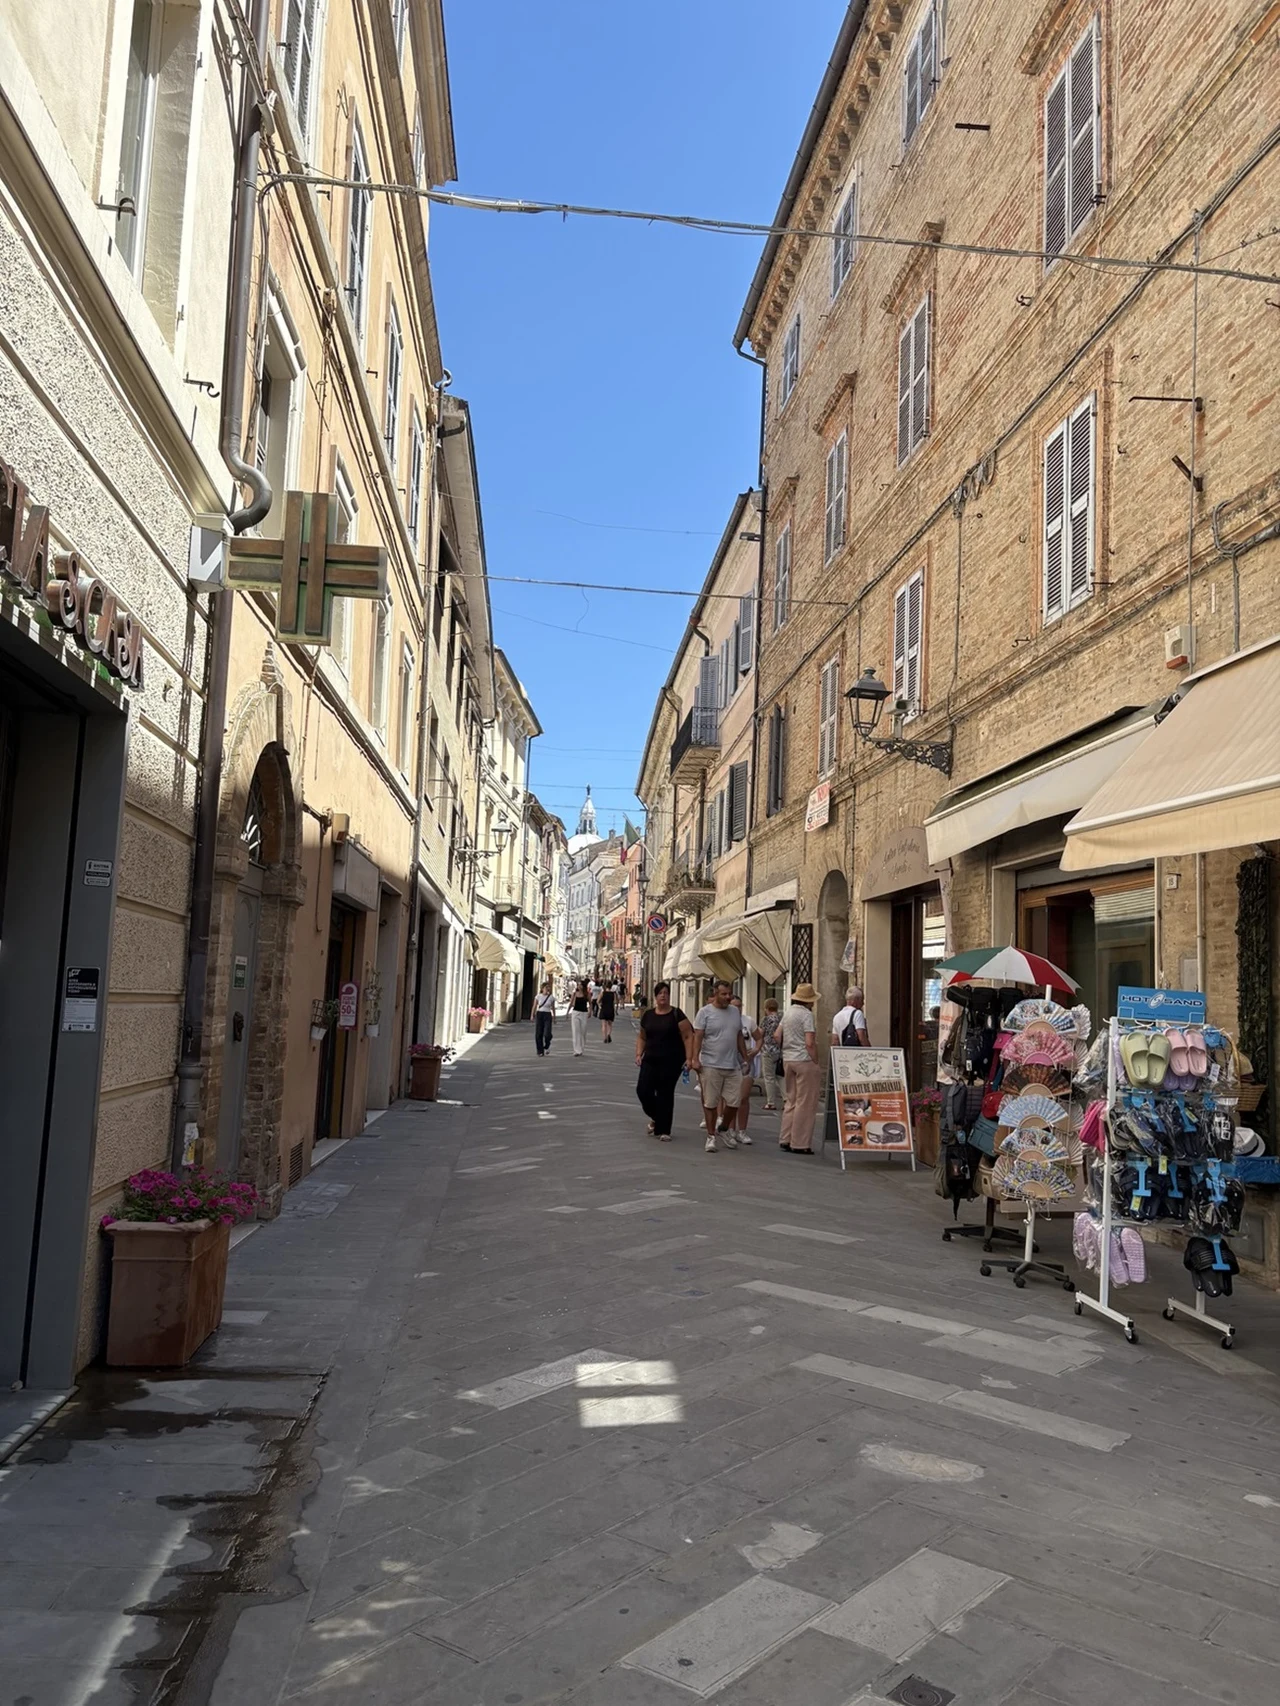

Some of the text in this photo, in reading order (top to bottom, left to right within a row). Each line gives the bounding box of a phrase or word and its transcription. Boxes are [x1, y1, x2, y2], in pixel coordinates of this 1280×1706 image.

[1121, 994, 1204, 1007] HOT SAND
[842, 1081, 902, 1095] LE CINTURE ARTIGIANALI
